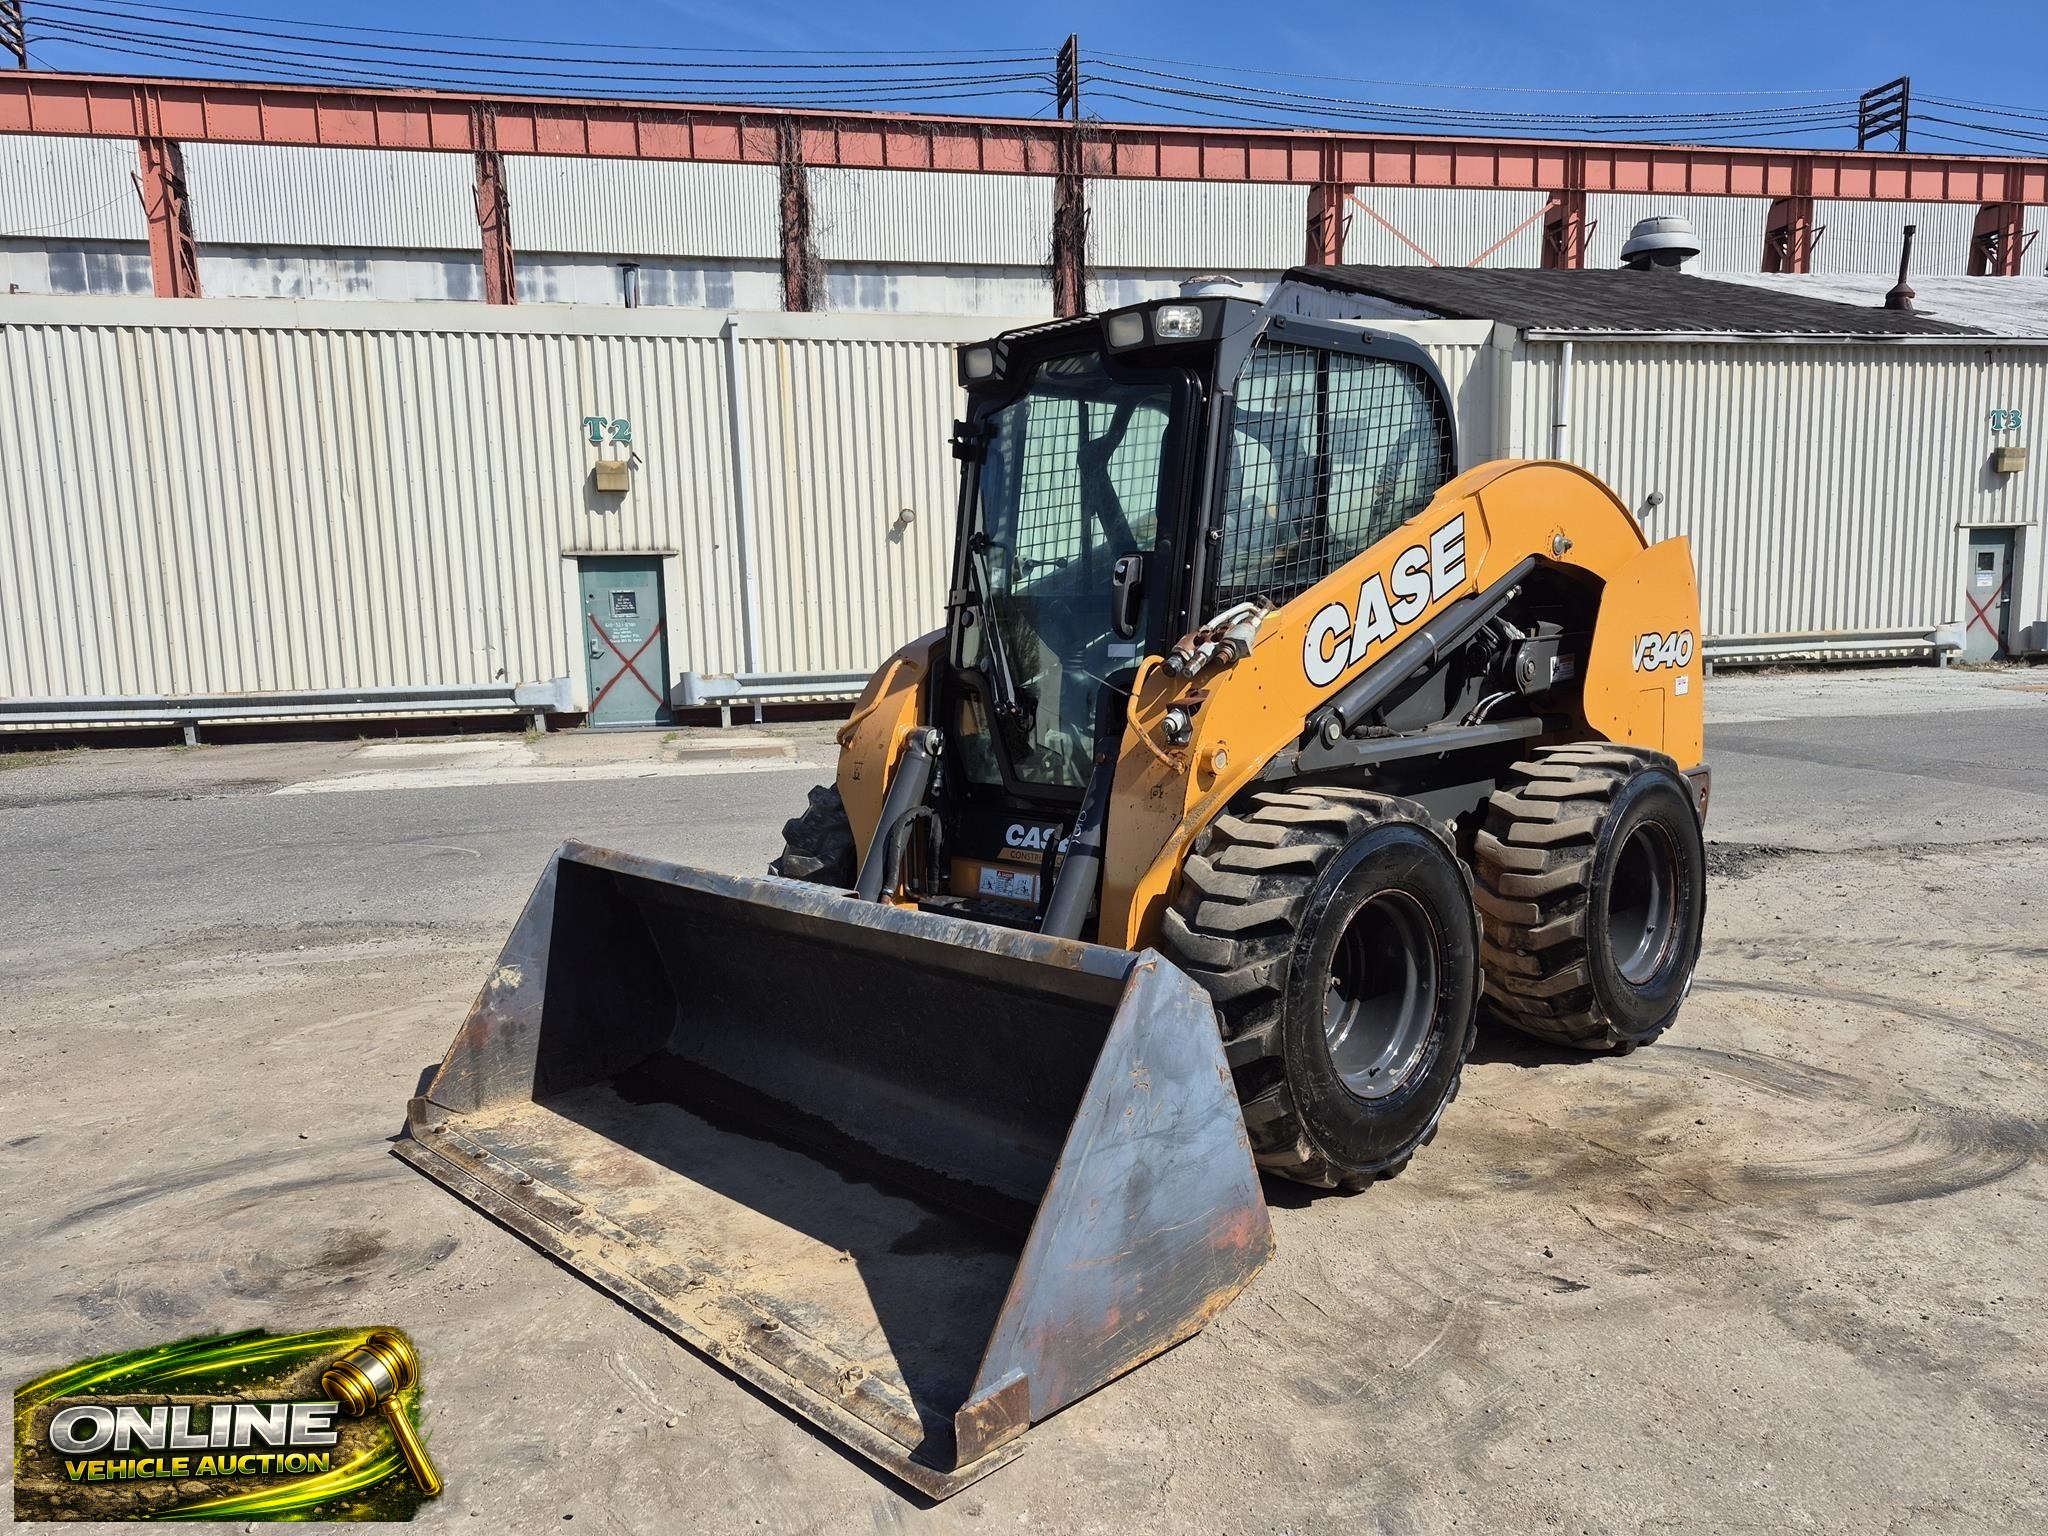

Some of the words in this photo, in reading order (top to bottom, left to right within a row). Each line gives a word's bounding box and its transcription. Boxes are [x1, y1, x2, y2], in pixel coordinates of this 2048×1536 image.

[583, 416, 632, 442] T2
[1990, 409, 2022, 430] T3
[1303, 511, 1467, 688] CASE
[1632, 629, 1694, 673] V340
